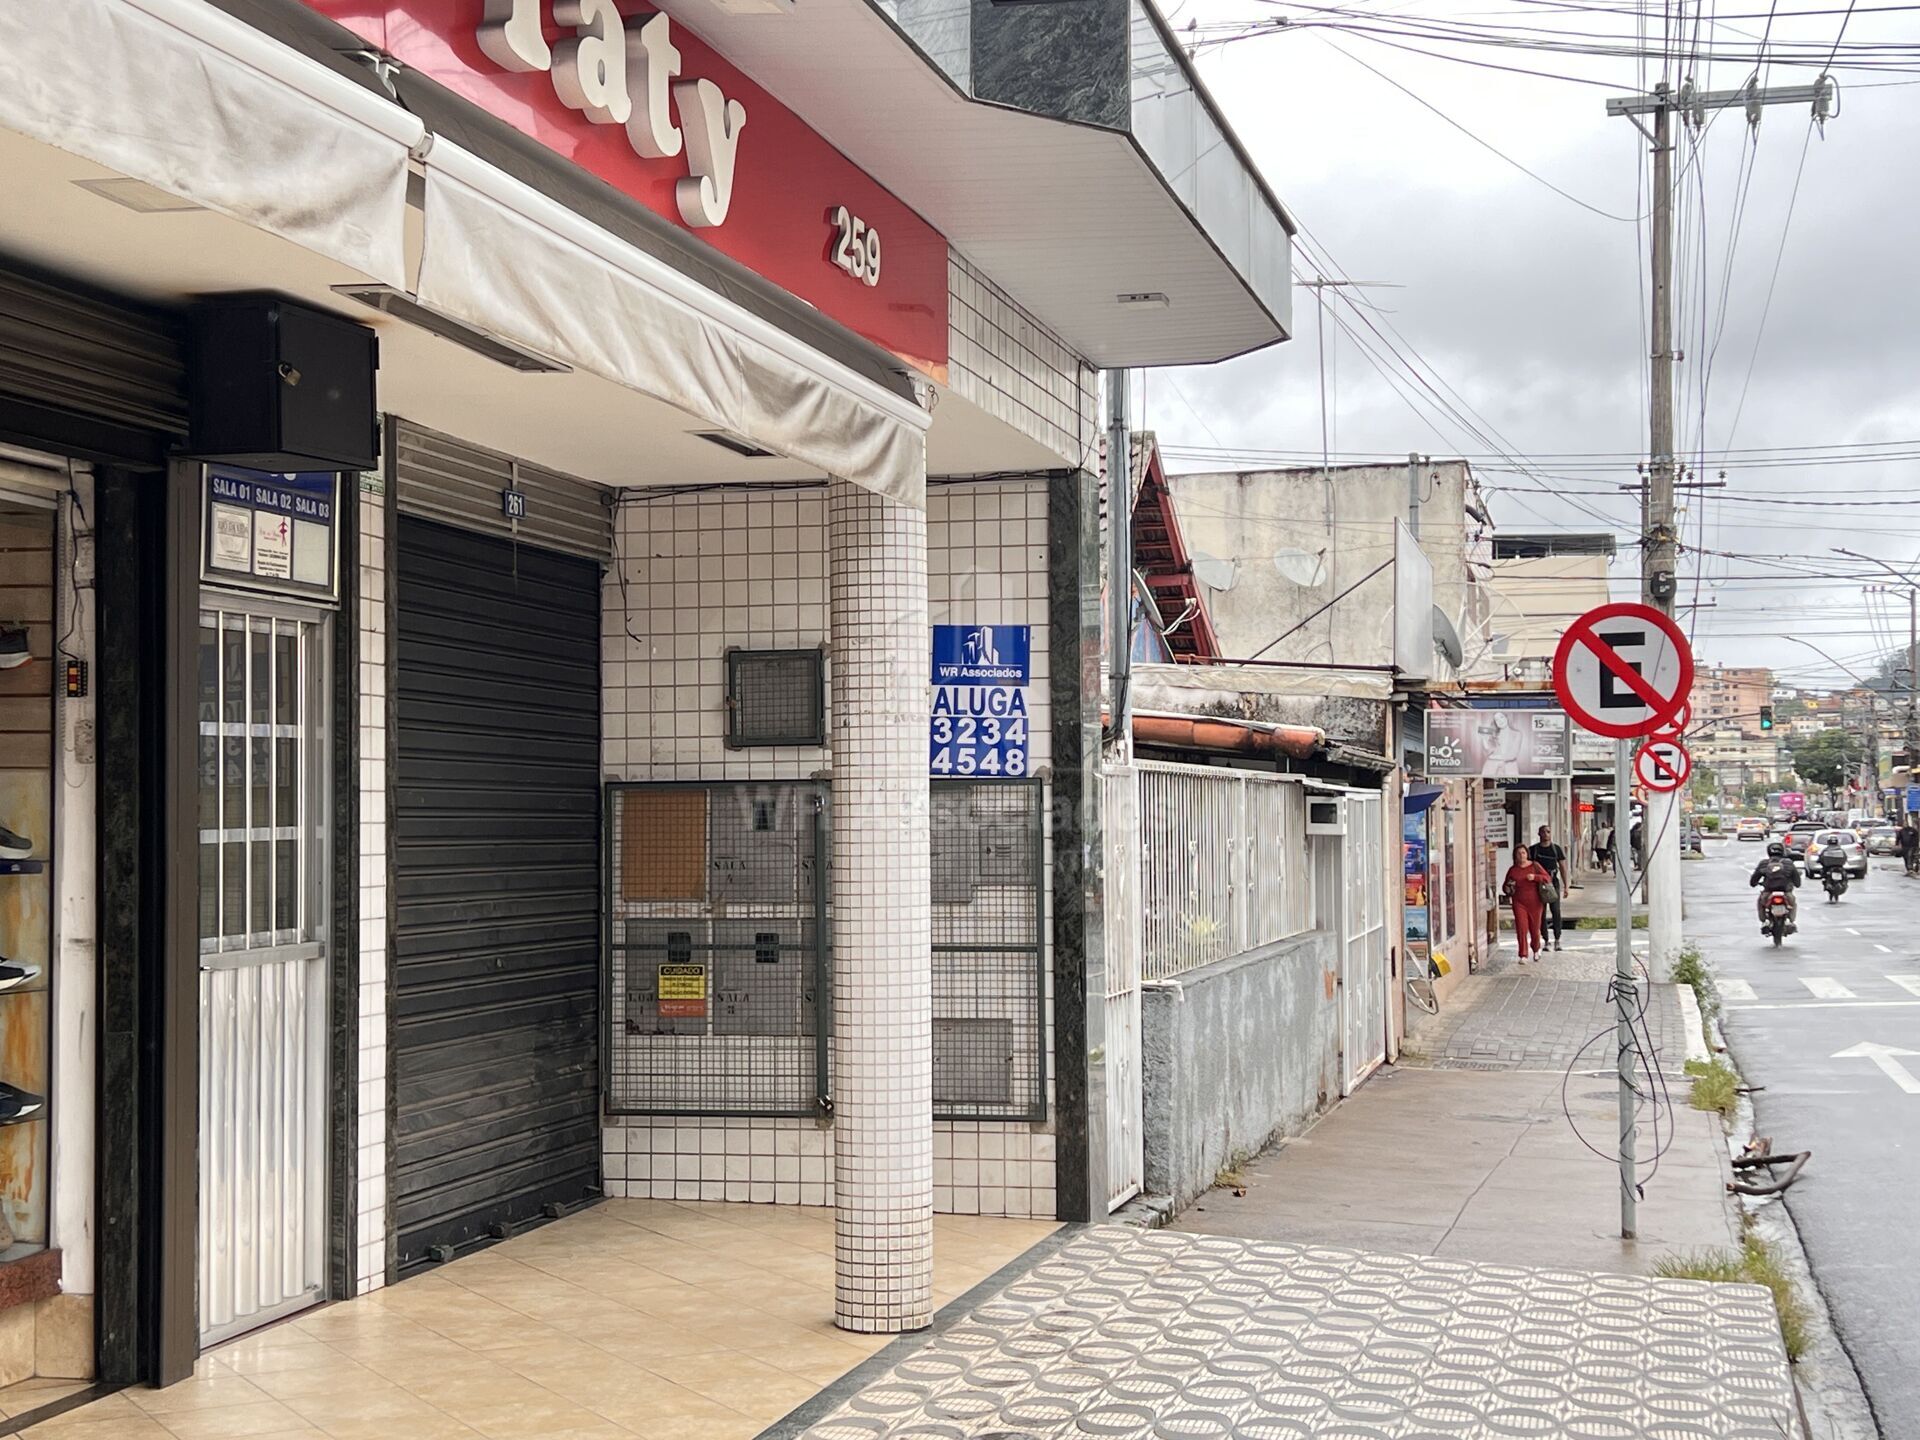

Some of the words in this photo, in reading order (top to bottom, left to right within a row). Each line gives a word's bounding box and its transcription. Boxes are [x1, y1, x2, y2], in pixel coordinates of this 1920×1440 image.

[831, 205, 881, 287] 259
[213, 478, 237, 498] SALA
[239, 484, 250, 500] 01
[255, 488, 278, 506] SALA
[280, 494, 292, 510] 02
[295, 497, 317, 515] SALA
[318, 502, 330, 518] 03
[508, 494, 523, 516] 261
[939, 666, 958, 677] WR
[960, 667, 1022, 678] Associados
[1599, 631, 1646, 709] E
[932, 687, 1027, 716] ALUGA
[933, 717, 1026, 746] 3234
[931, 746, 1024, 776] 4548
[663, 967, 700, 975] CUIDADO
